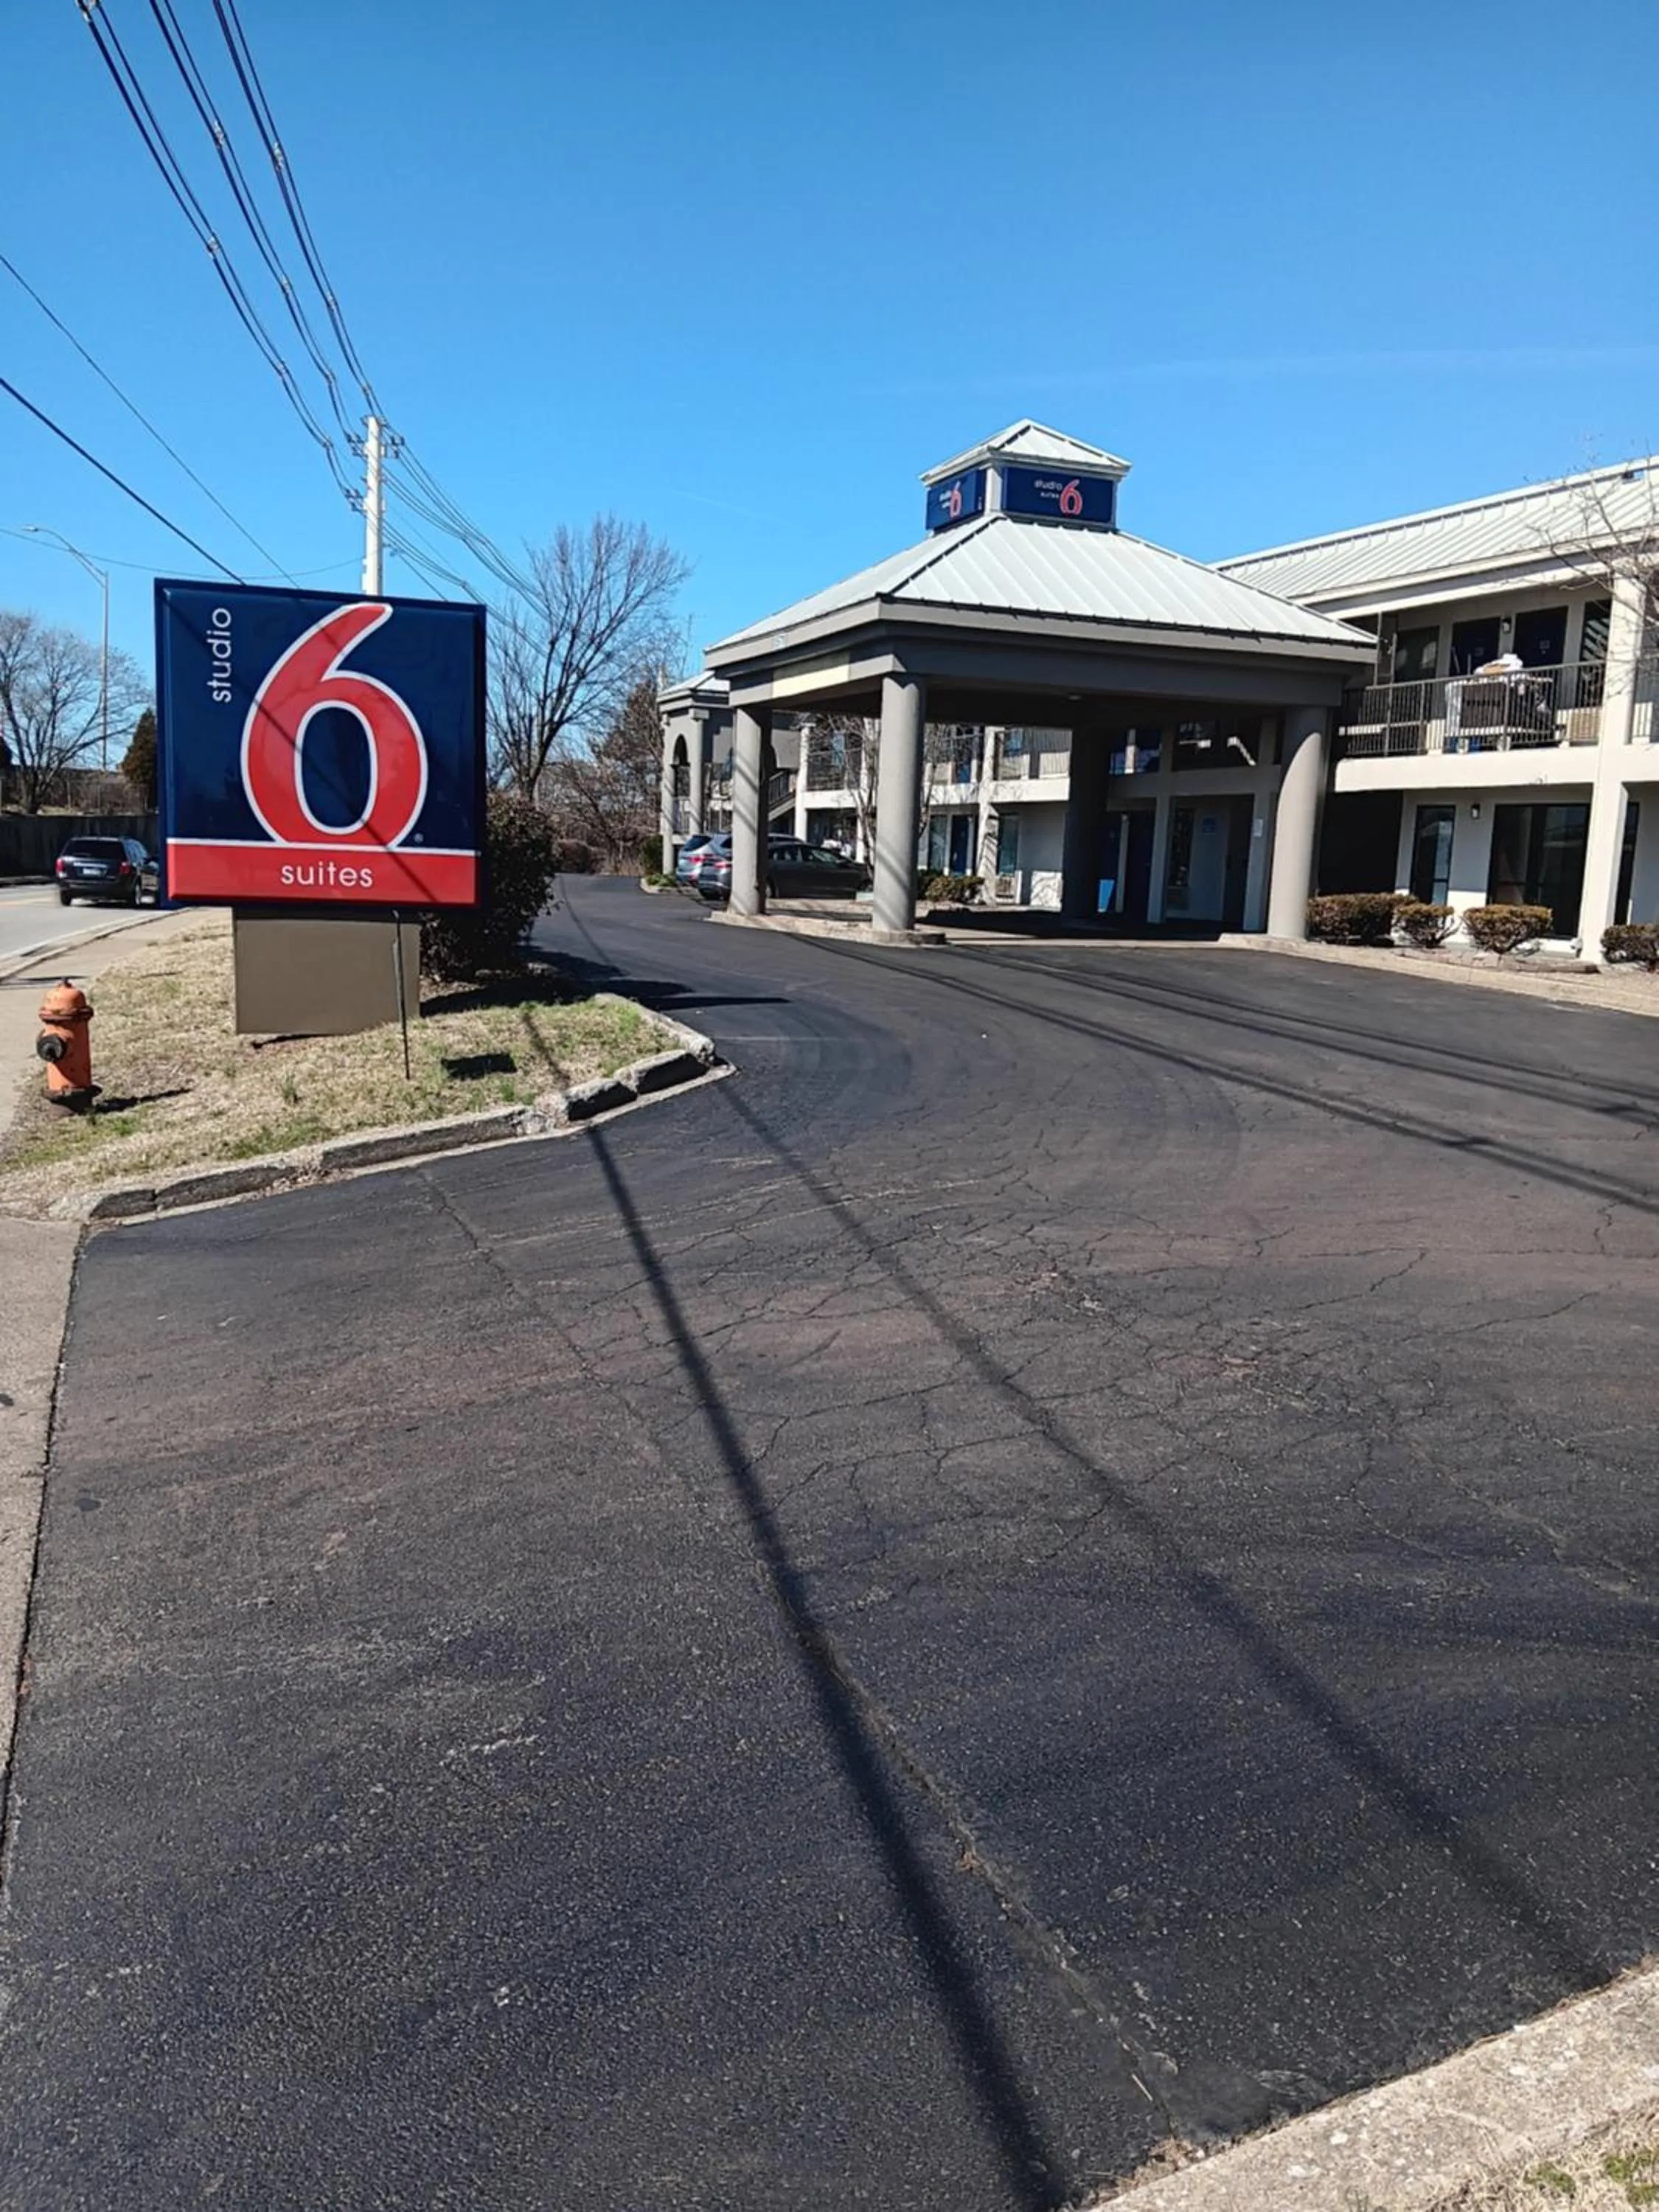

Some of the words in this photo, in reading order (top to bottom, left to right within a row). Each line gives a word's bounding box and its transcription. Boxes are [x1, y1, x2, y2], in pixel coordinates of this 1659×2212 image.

[950, 481, 961, 518] 6
[1060, 479, 1082, 515] 6
[206, 607, 232, 703] studio
[240, 602, 428, 849] 6
[281, 861, 373, 888] suites
